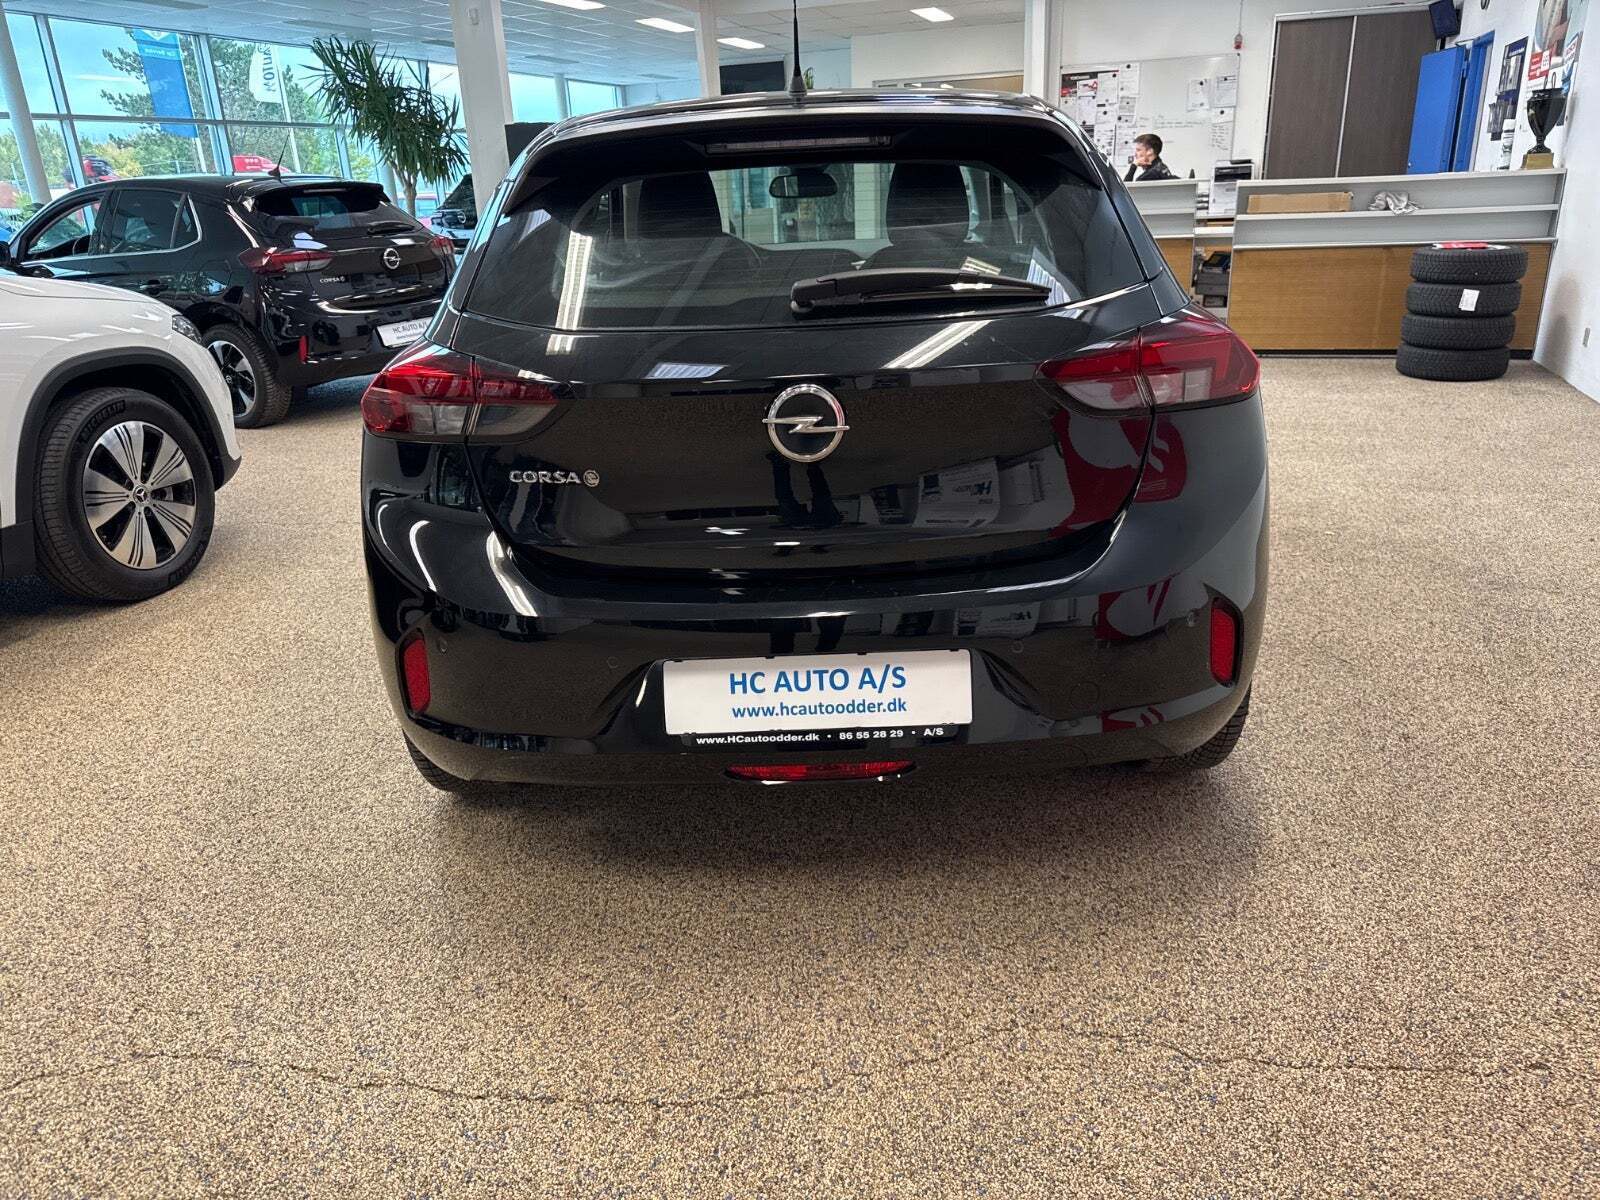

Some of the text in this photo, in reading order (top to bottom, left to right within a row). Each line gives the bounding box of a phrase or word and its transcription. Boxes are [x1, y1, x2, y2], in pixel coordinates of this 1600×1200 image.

[402, 323, 418, 332] AUTO
[509, 470, 582, 484] CORSA
[729, 664, 907, 695] HC AUTO A/S
[731, 698, 907, 719] www.hcautoodder.dk
[696, 727, 944, 745] www.HCautoodder.dk 86 55 28 29 A/S
